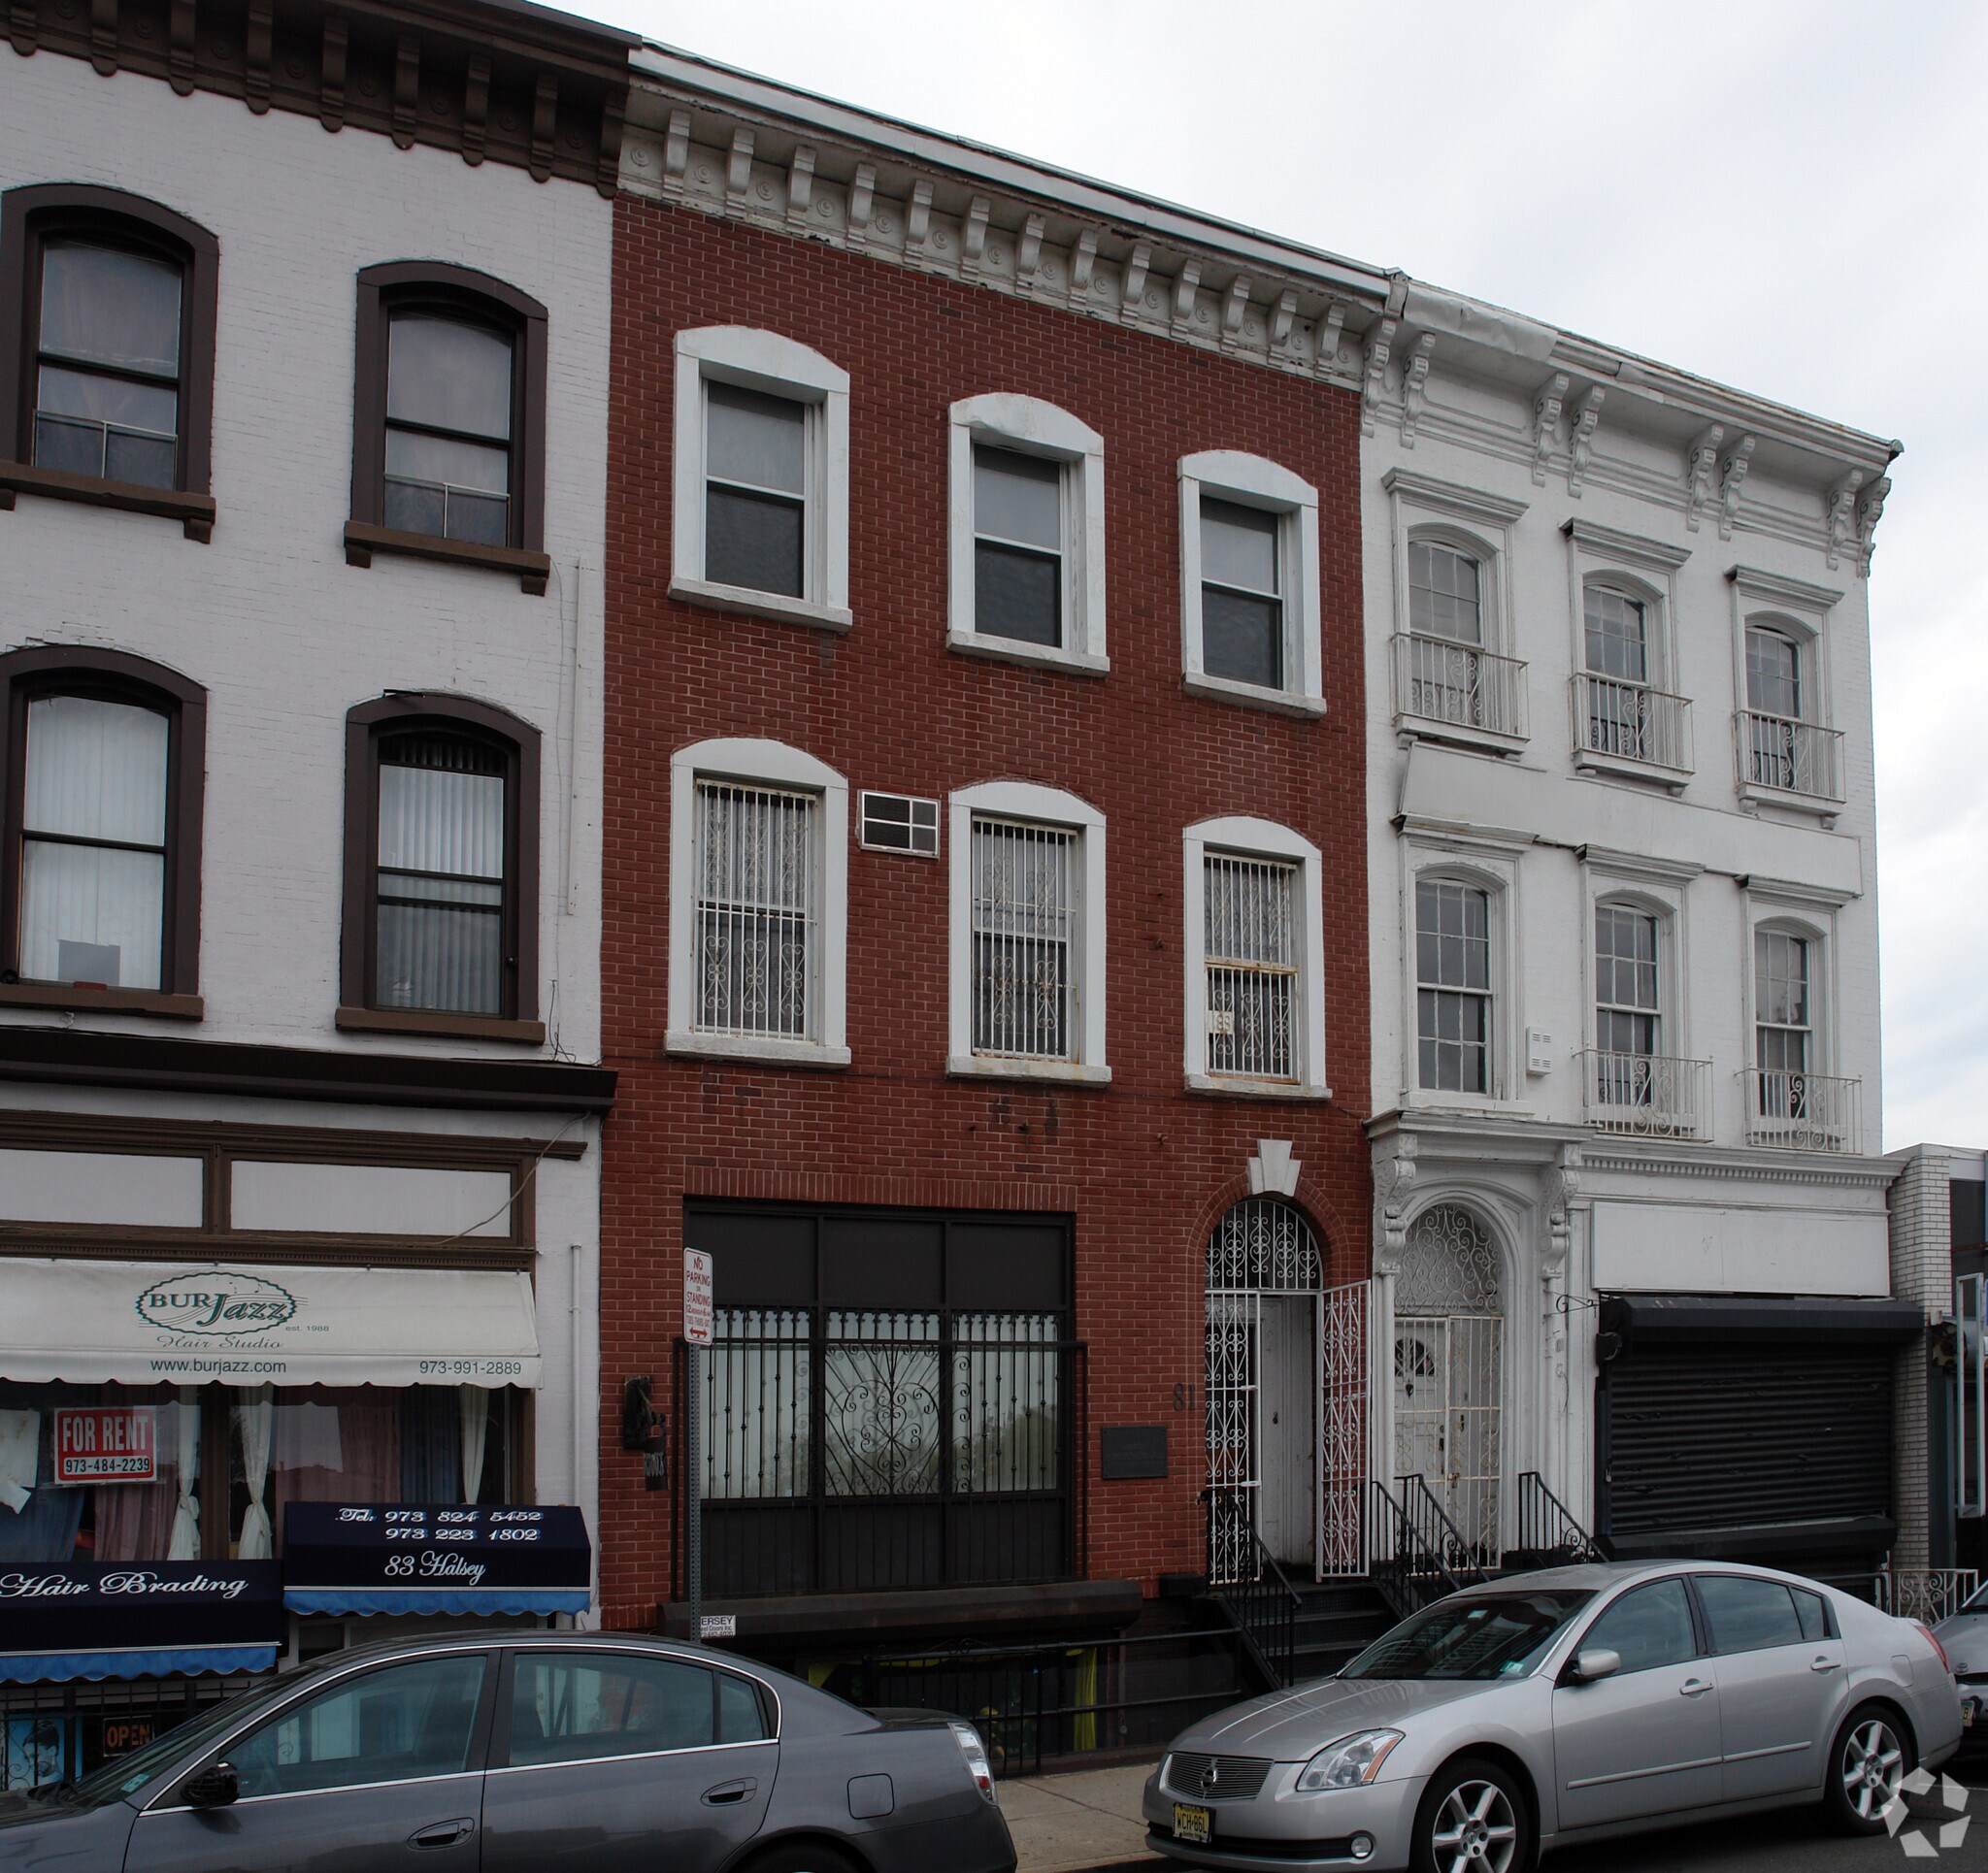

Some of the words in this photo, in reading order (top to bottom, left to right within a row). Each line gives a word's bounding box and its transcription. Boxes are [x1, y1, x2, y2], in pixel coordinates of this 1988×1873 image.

[693, 1258, 703, 1270] NO
[686, 1270, 711, 1286] PARKING
[686, 1292, 711, 1307] STANDING
[156, 1335, 213, 1348] Hair
[219, 1335, 283, 1348] Studio
[150, 1359, 286, 1375] www.burjazz.com
[419, 1361, 521, 1374] 973-991-2889
[1173, 1382, 1195, 1411] 81
[62, 1416, 96, 1452] FOR
[102, 1416, 149, 1451] RENT
[65, 1458, 150, 1472] 973-484-2239
[384, 1511, 426, 1522] 973
[437, 1511, 480, 1522] 824
[489, 1511, 543, 1522] 5452
[385, 1528, 427, 1539] 973
[435, 1528, 476, 1540] 223
[488, 1528, 540, 1540] 1802
[384, 1555, 415, 1576] 83
[419, 1551, 485, 1586] Halsey
[0, 1573, 90, 1597] Hair
[99, 1571, 248, 1598] Brading
[701, 1616, 733, 1626] ERSEY
[106, 1724, 150, 1748] OPEN
